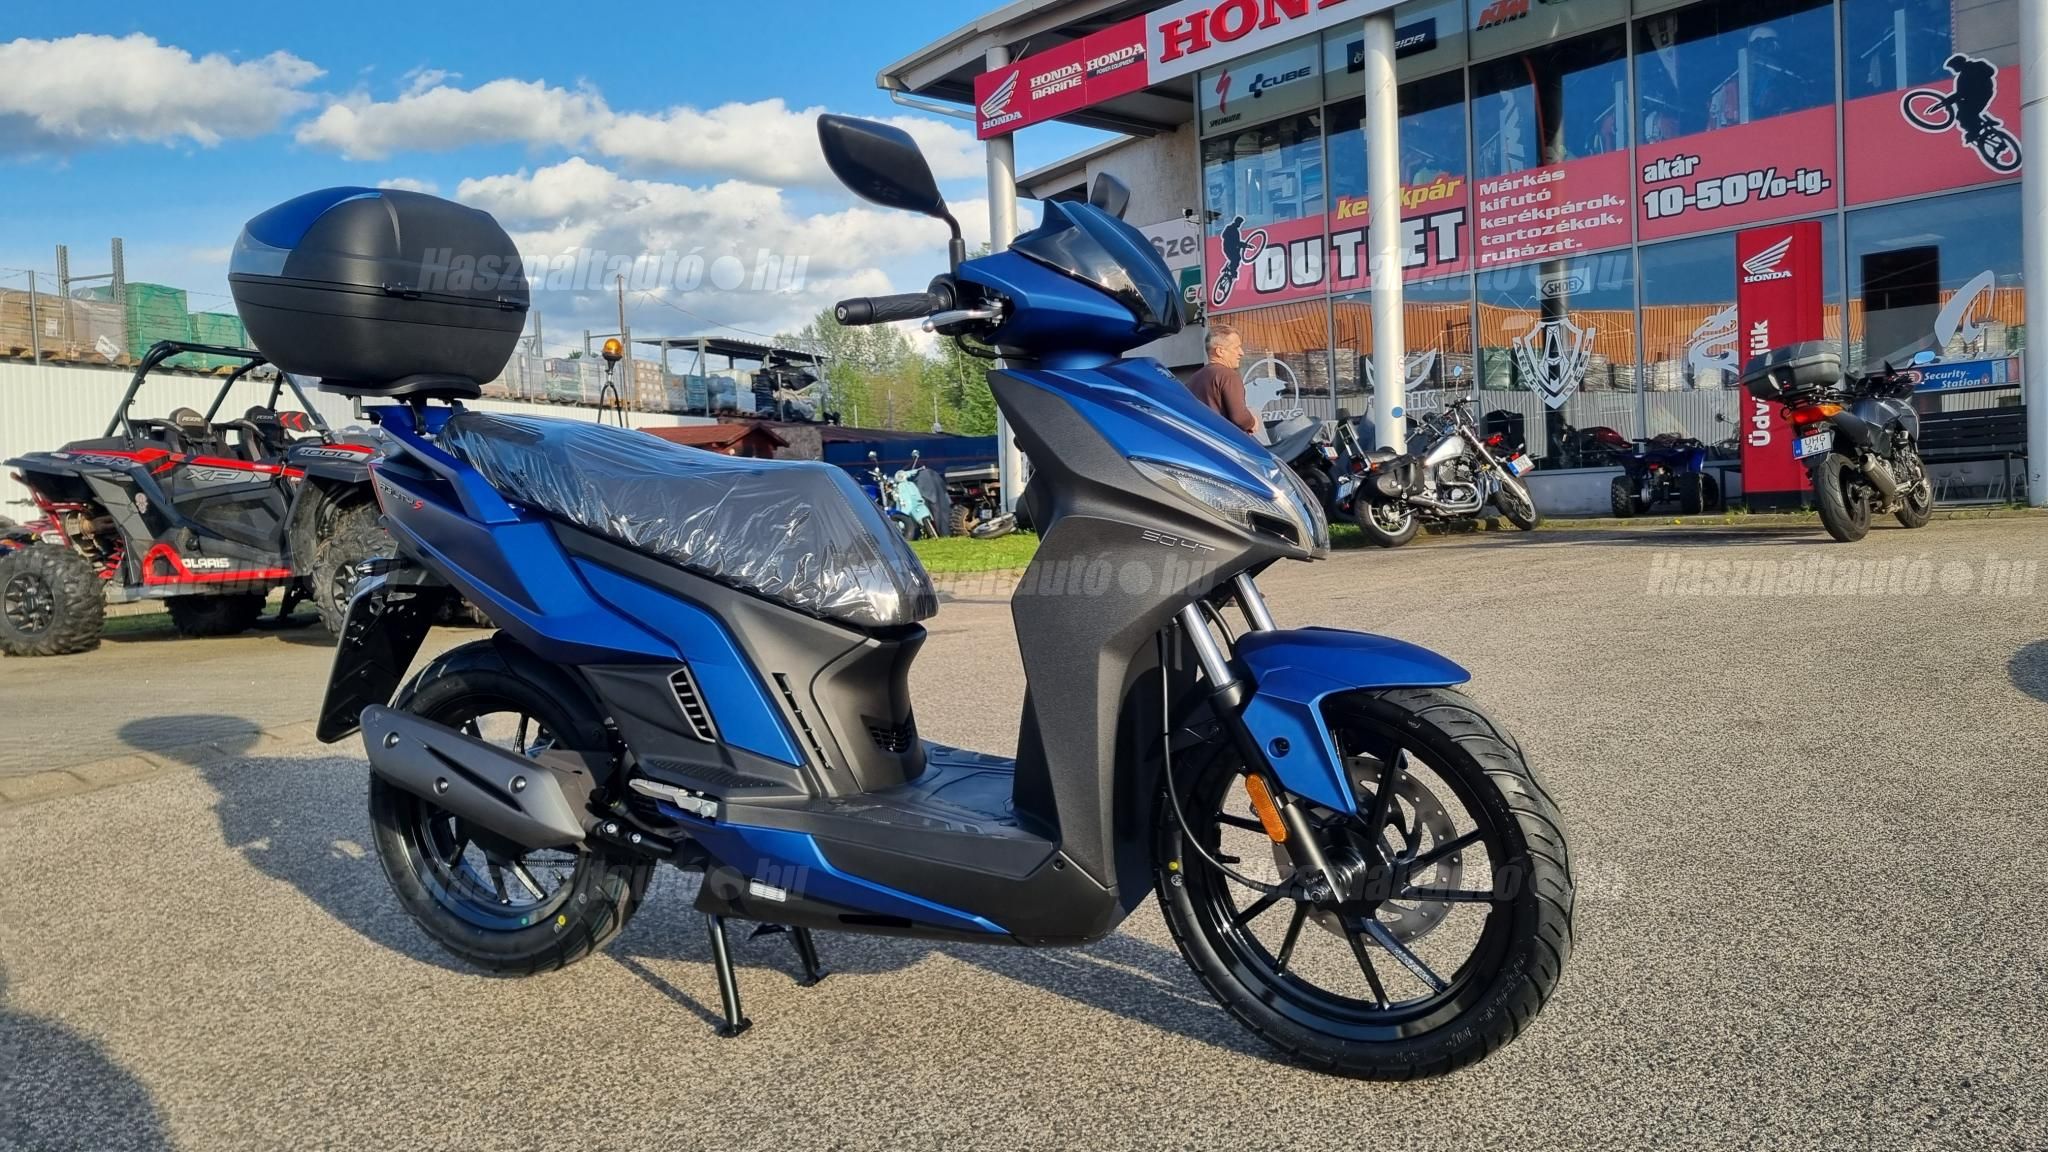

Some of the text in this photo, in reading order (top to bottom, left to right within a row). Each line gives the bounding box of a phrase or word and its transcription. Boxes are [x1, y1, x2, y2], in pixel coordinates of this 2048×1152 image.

[1159, 0, 1352, 63] HON
[1086, 43, 1147, 72] HONDA
[1096, 65, 1111, 75] POWER
[1030, 62, 1083, 88] HONDA
[1032, 75, 1083, 100] MARINE
[1261, 66, 1311, 88] CUBE
[982, 111, 1023, 130] HONDA
[1644, 155, 1700, 183] akár
[1479, 170, 1566, 196] Márkás
[1337, 178, 1462, 220] kekpár
[1480, 188, 1552, 213] kifutó
[1480, 194, 1626, 230] kerékpárok,
[1480, 213, 1624, 247] tartozékok,
[1254, 207, 1466, 294] OUTET
[1481, 238, 1583, 263] ruházat.
[1548, 279, 1578, 294] SHOEI
[1743, 270, 1793, 284] HONDA
[1924, 369, 1970, 381] Security-
[1941, 378, 1981, 389] Station
[1261, 408, 1304, 422] RING
[181, 557, 230, 569] OLARIS
